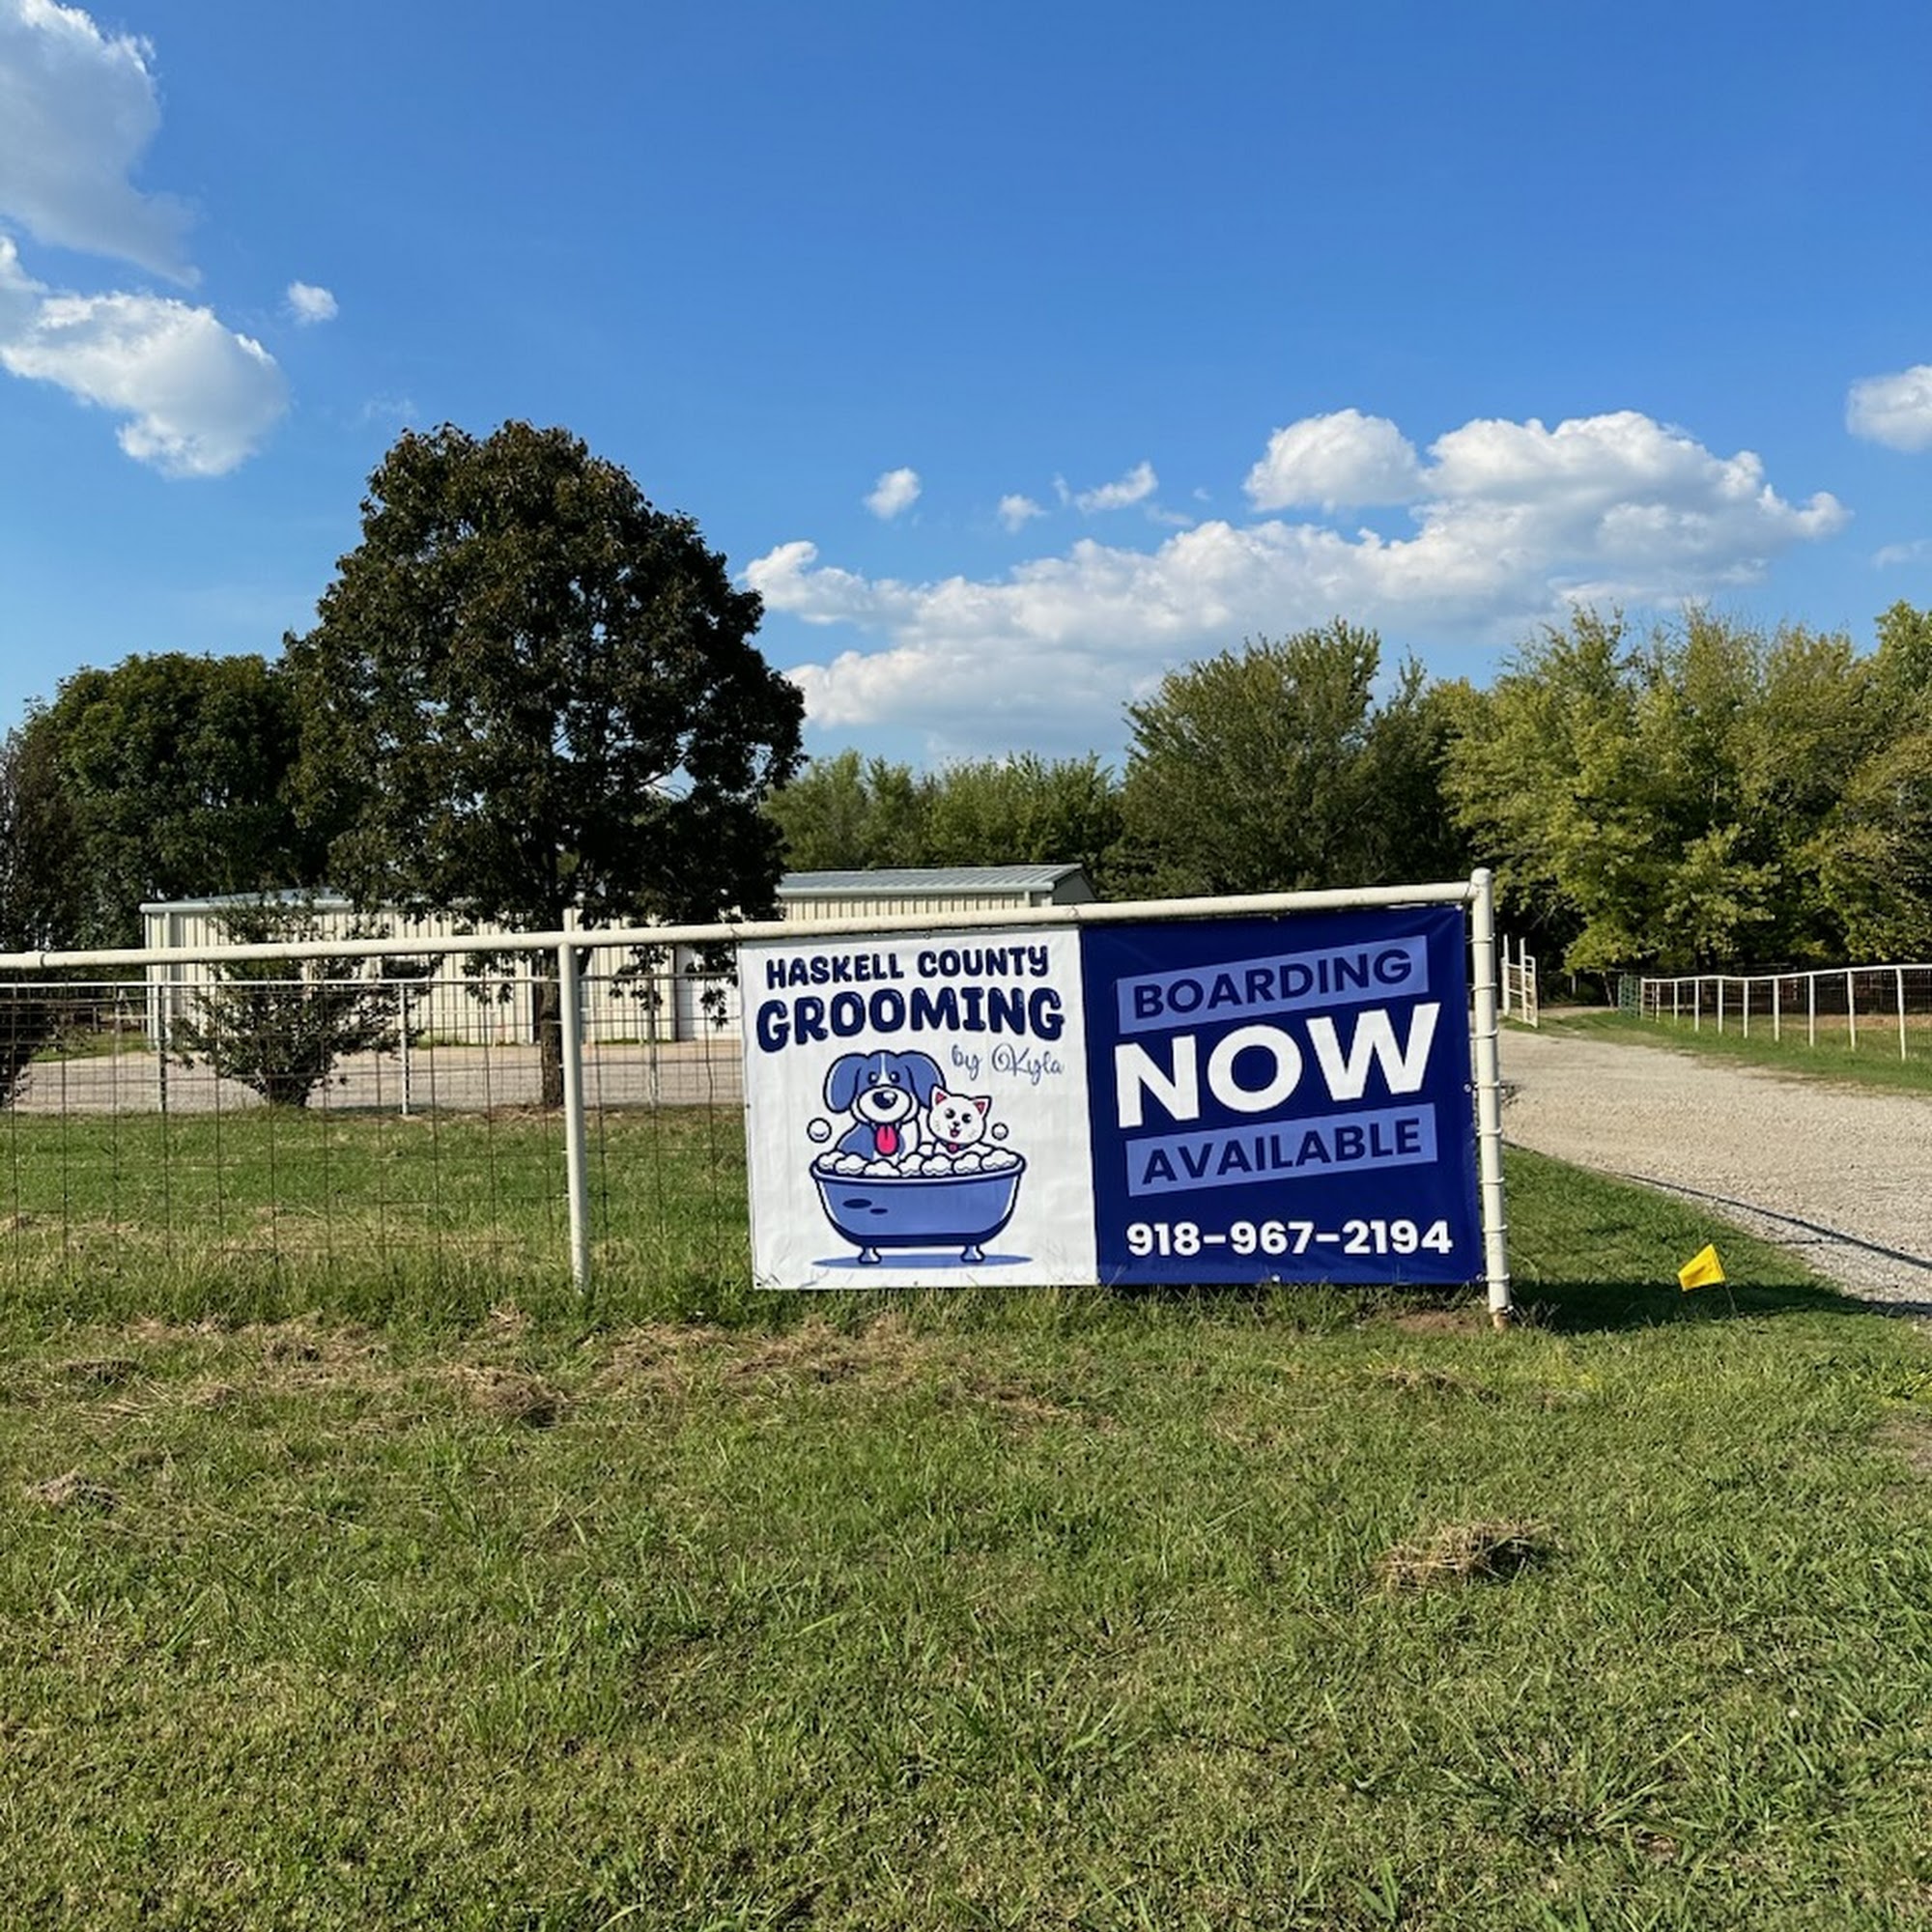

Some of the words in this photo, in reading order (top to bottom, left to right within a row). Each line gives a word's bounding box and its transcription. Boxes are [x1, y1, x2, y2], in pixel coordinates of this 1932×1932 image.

[766, 952, 904, 989] HASKELL
[918, 945, 1048, 978] COUNTY
[1134, 949, 1412, 1020] BOARDING
[756, 986, 1065, 1053] GROOMING
[951, 1043, 982, 1080] by
[1114, 1002, 1440, 1129] NOW
[1141, 1118, 1421, 1185] AVAILABLE
[1126, 1219, 1453, 1256] 918-967-2194
